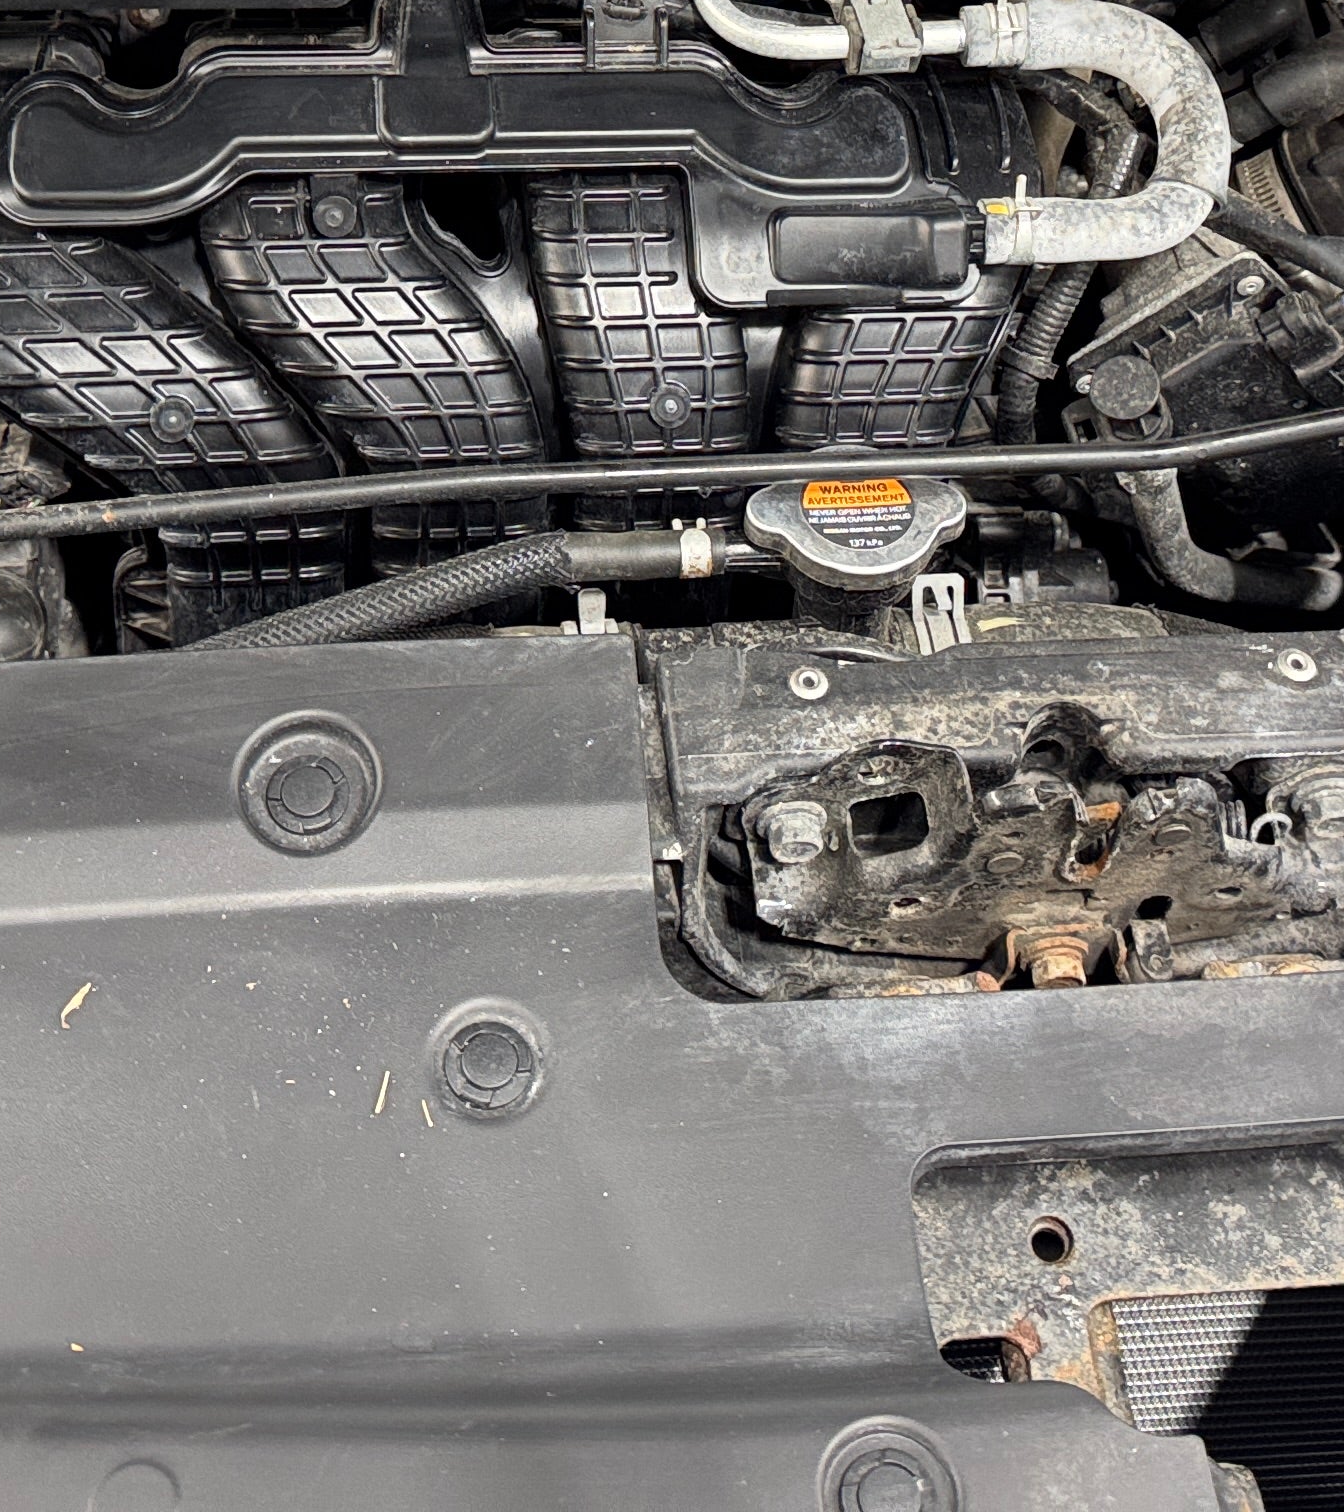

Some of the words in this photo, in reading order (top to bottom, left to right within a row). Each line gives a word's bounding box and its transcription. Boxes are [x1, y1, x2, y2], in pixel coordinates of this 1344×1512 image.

[818, 482, 888, 495] WARNING
[807, 493, 905, 505] AVERTISSEMENT
[849, 538, 865, 547] 137
